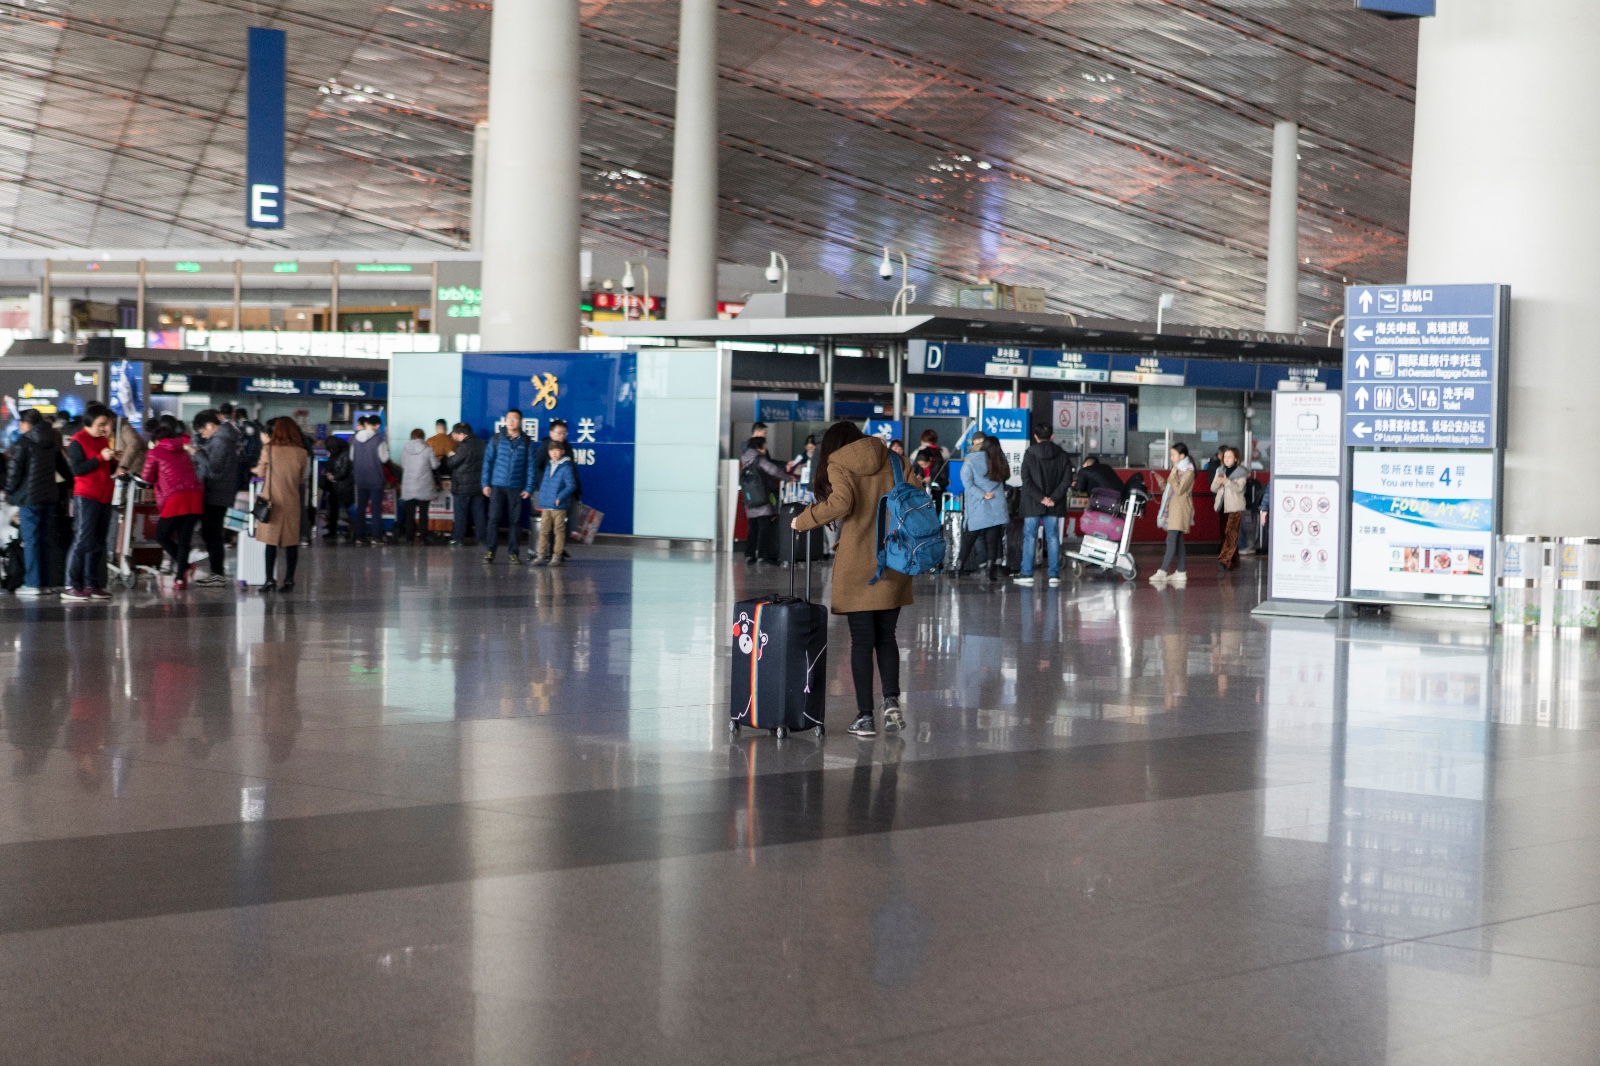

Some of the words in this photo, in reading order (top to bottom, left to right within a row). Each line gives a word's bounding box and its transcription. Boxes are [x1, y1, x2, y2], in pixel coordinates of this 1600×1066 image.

[252, 184, 279, 223] E
[1402, 289, 1433, 302] 登机口
[1402, 303, 1423, 313] Gates
[927, 345, 942, 369] D
[1436, 368, 1462, 380] Baggage
[1443, 387, 1475, 400] 洗手间
[1443, 401, 1461, 410] Toilet
[1381, 464, 1435, 476] 您所在楼层
[1439, 467, 1452, 486] 4
[1456, 465, 1465, 476] 层
[1381, 478, 1398, 488] You
[1400, 480, 1414, 488] are
[1416, 479, 1434, 488] here
[1458, 480, 1462, 488] F
[1390, 497, 1430, 514] FOOD
[1436, 501, 1457, 517] AT
[1462, 506, 1480, 521] 2F
